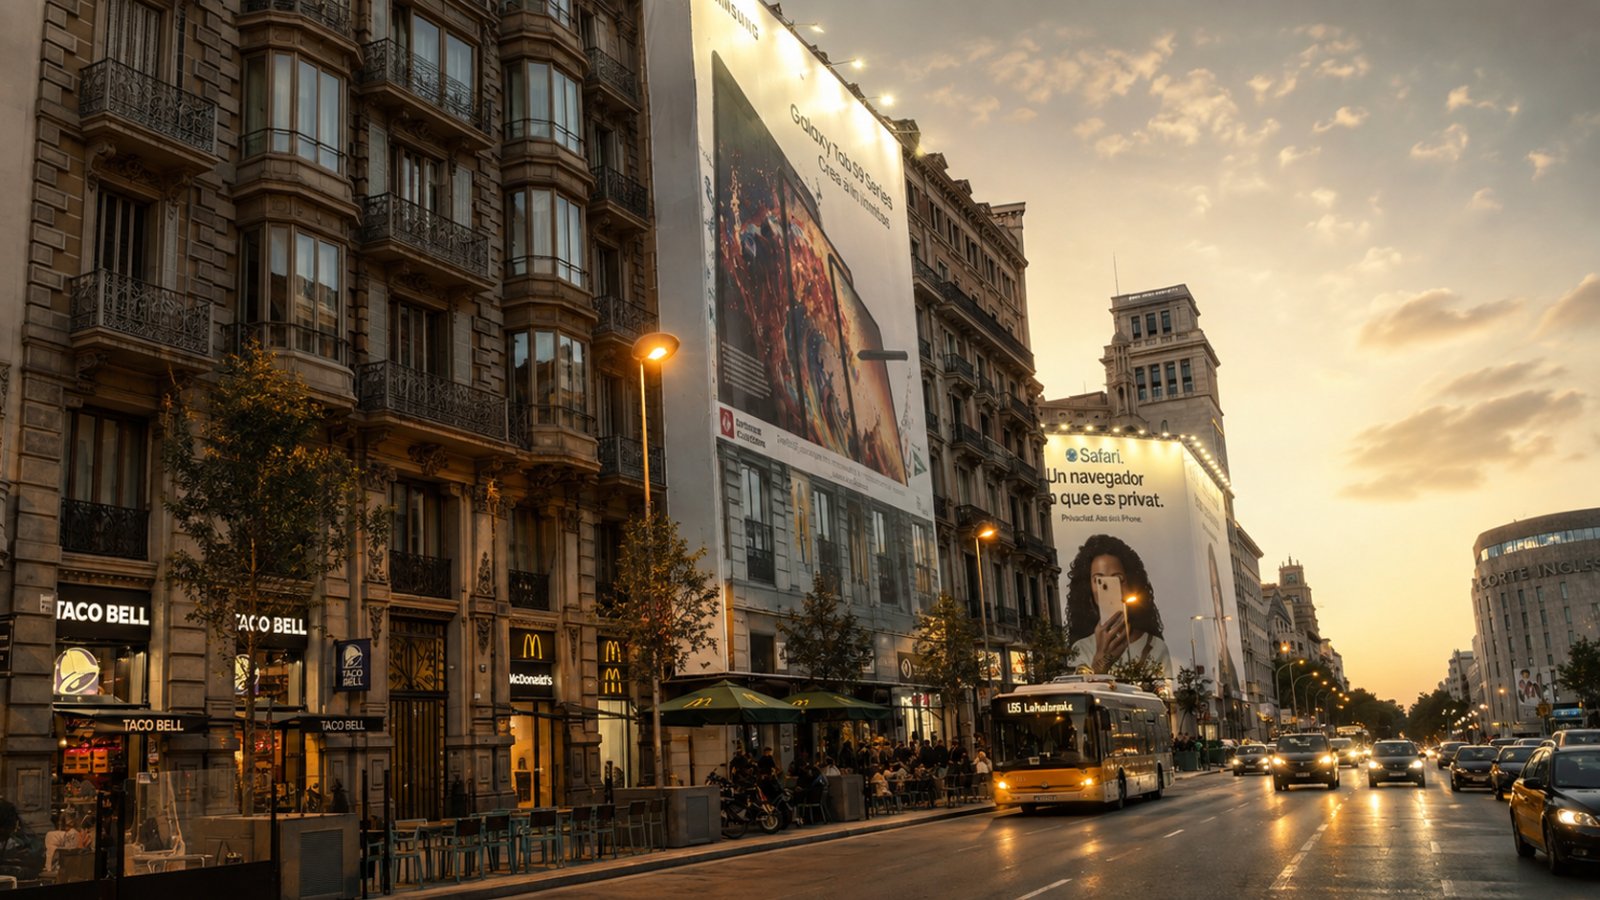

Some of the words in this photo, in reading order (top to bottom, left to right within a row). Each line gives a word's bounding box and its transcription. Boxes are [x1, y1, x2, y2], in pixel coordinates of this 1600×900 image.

[790, 103, 831, 158] Galaxy
[832, 143, 852, 173] Tab
[865, 172, 893, 211] Series
[818, 155, 842, 186] Crea
[1079, 447, 1124, 465] Safari.
[1047, 467, 1067, 484] Un
[1070, 469, 1144, 489] navegador
[1060, 492, 1090, 509] que
[1118, 490, 1165, 510] privat.
[1480, 567, 1529, 590] CORTE
[56, 600, 103, 622] TACO
[106, 604, 150, 626] BELL
[273, 616, 308, 636] BELL
[342, 669, 364, 678] TACO
[342, 678, 364, 687] BELL
[508, 673, 553, 686] McDonald's
[122, 719, 154, 732] TACO
[156, 719, 185, 732] BELL
[321, 720, 345, 731] TACO
[345, 721, 366, 731] BELL
